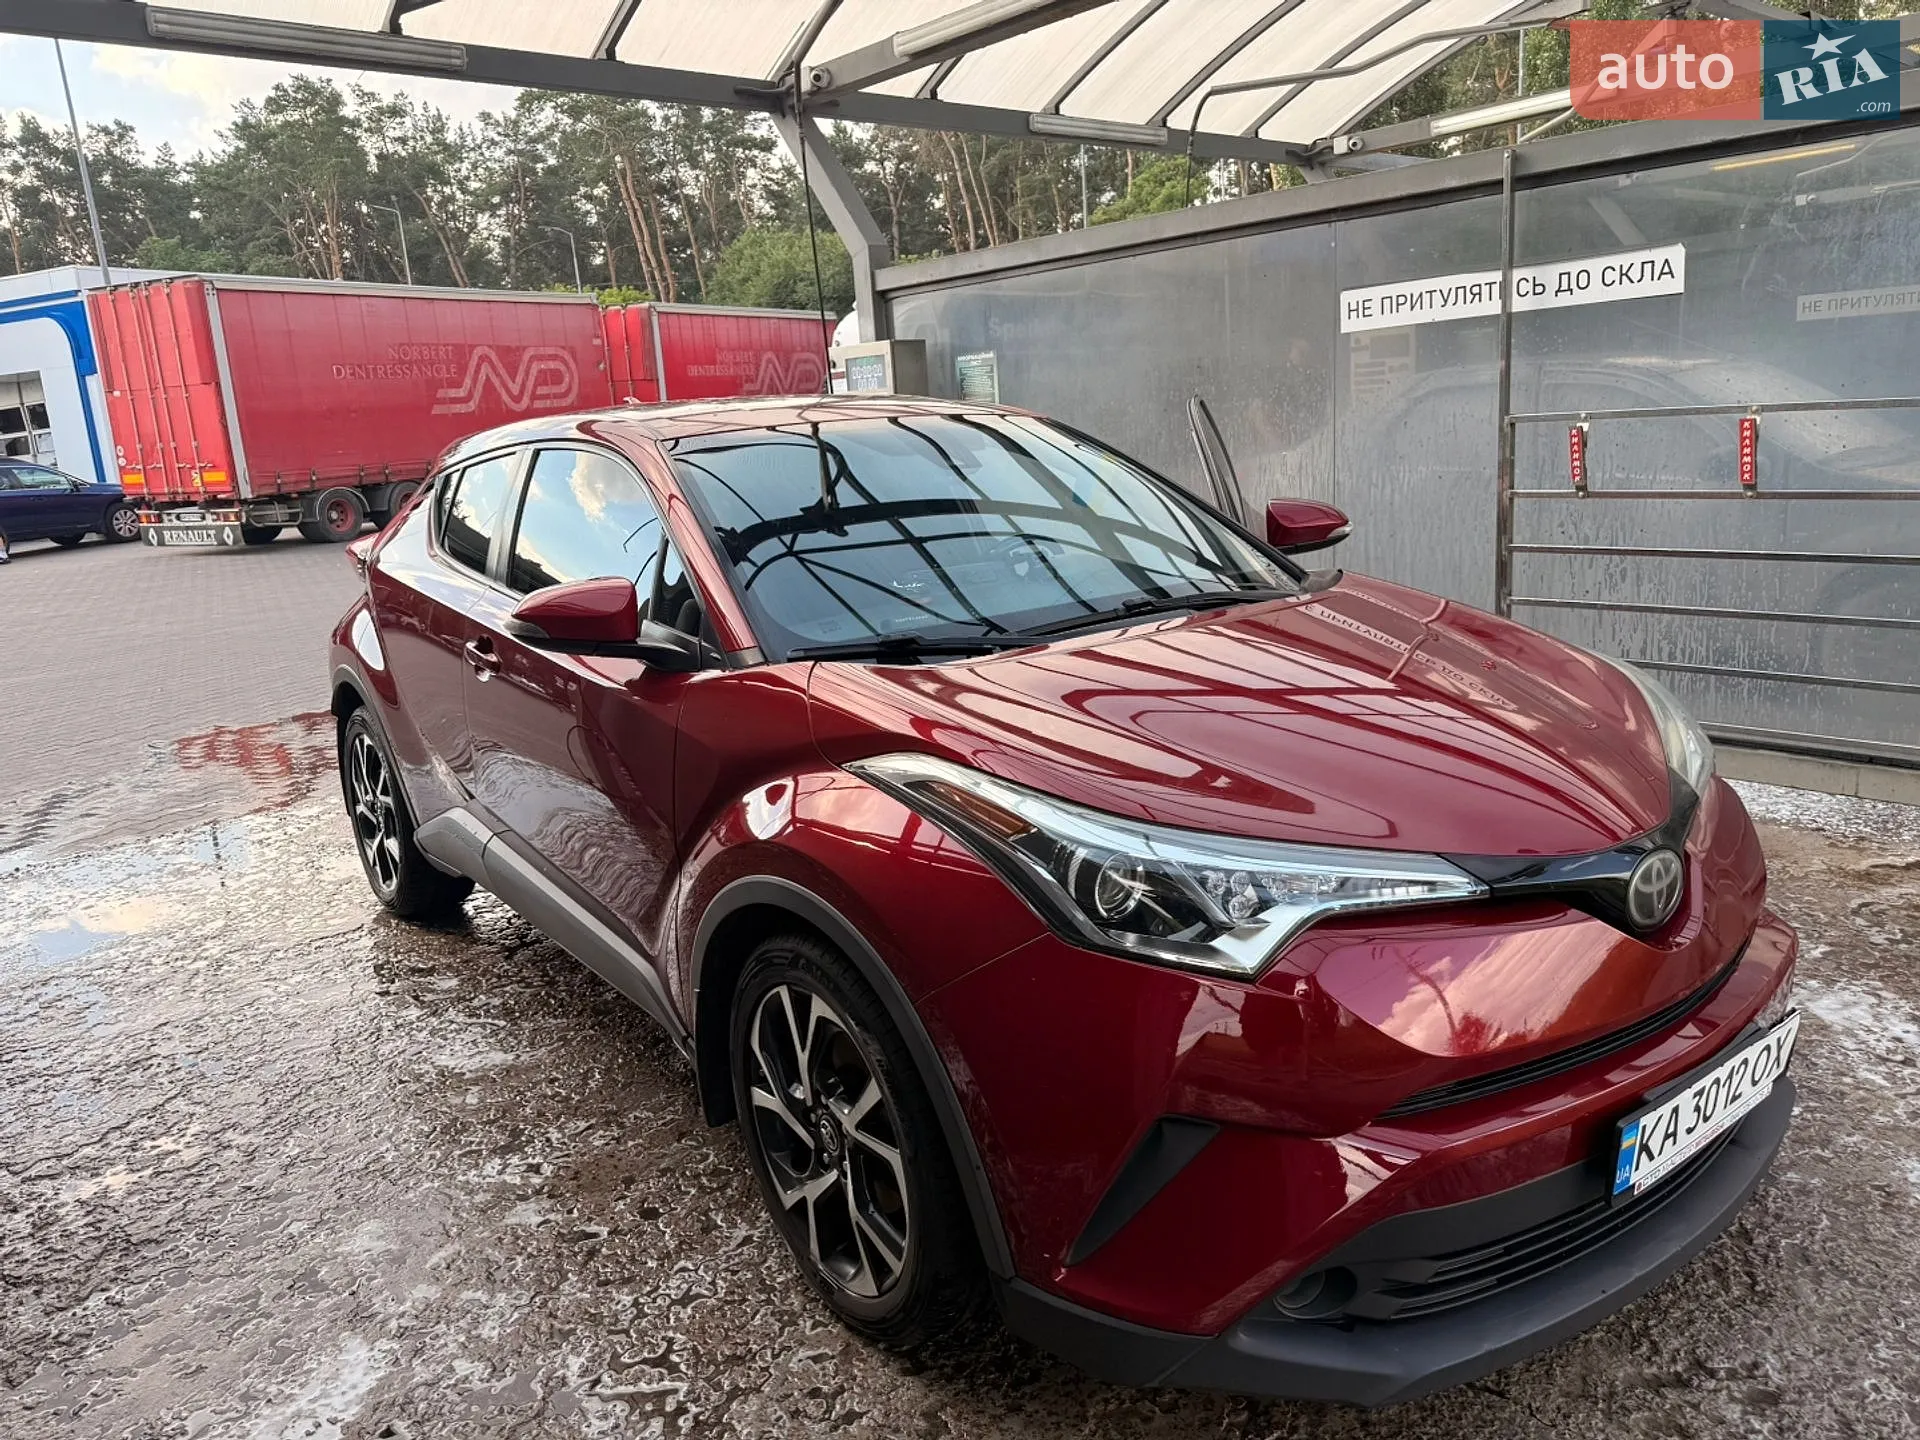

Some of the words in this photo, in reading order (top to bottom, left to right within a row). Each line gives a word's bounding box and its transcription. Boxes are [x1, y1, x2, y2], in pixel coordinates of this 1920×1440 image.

[1347, 298, 1374, 320] НЕ
[1380, 276, 1547, 315] ПРИТУЛЯТСЬ
[1554, 268, 1592, 296] ДО
[1601, 257, 1676, 288] СКЛА
[1801, 299, 1823, 314] НЕ
[1827, 291, 1920, 312] ПРИТУЛЯТ
[388, 345, 455, 361] NORBERT
[332, 362, 458, 380] DENTRESSANGLE
[1742, 420, 1753, 481] КИЛИМОК
[163, 530, 217, 543] RENAULT
[1616, 1163, 1631, 1183] UA
[1634, 1104, 1680, 1172] KA
[1685, 1056, 1749, 1136] 3012
[1750, 1027, 1792, 1088] OX
